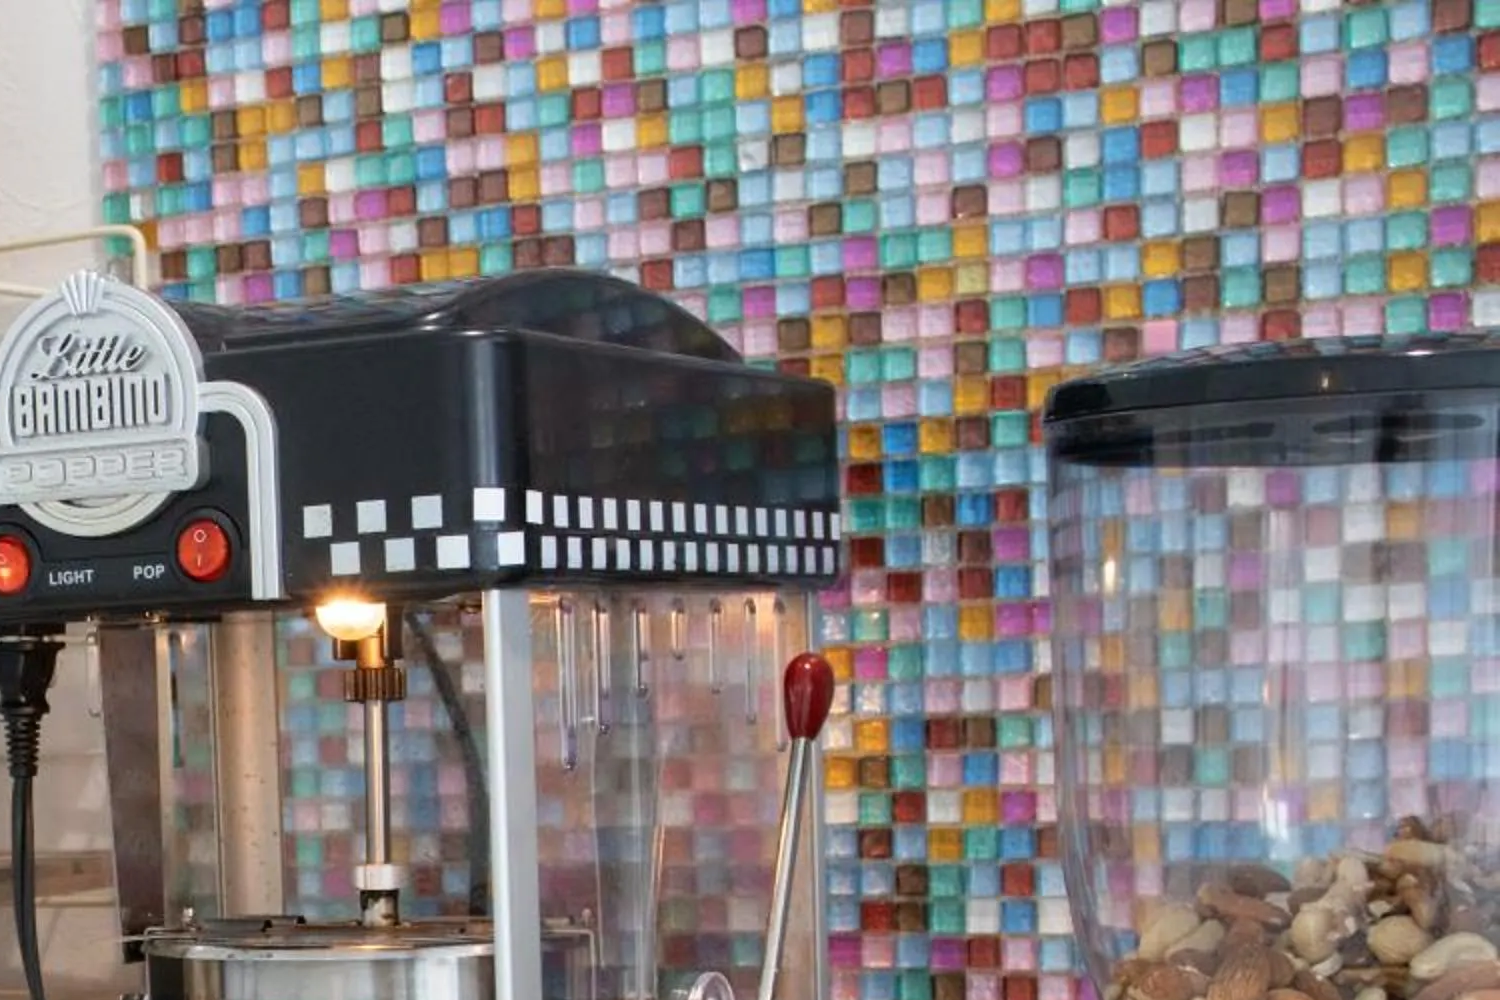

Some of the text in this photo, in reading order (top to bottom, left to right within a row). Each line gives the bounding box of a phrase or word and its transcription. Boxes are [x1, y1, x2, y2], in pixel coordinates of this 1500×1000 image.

[31, 333, 145, 381] Little
[10, 372, 172, 438] BAMBINO
[6, 447, 188, 487] POPPER
[49, 565, 165, 585] LIGHT POP
